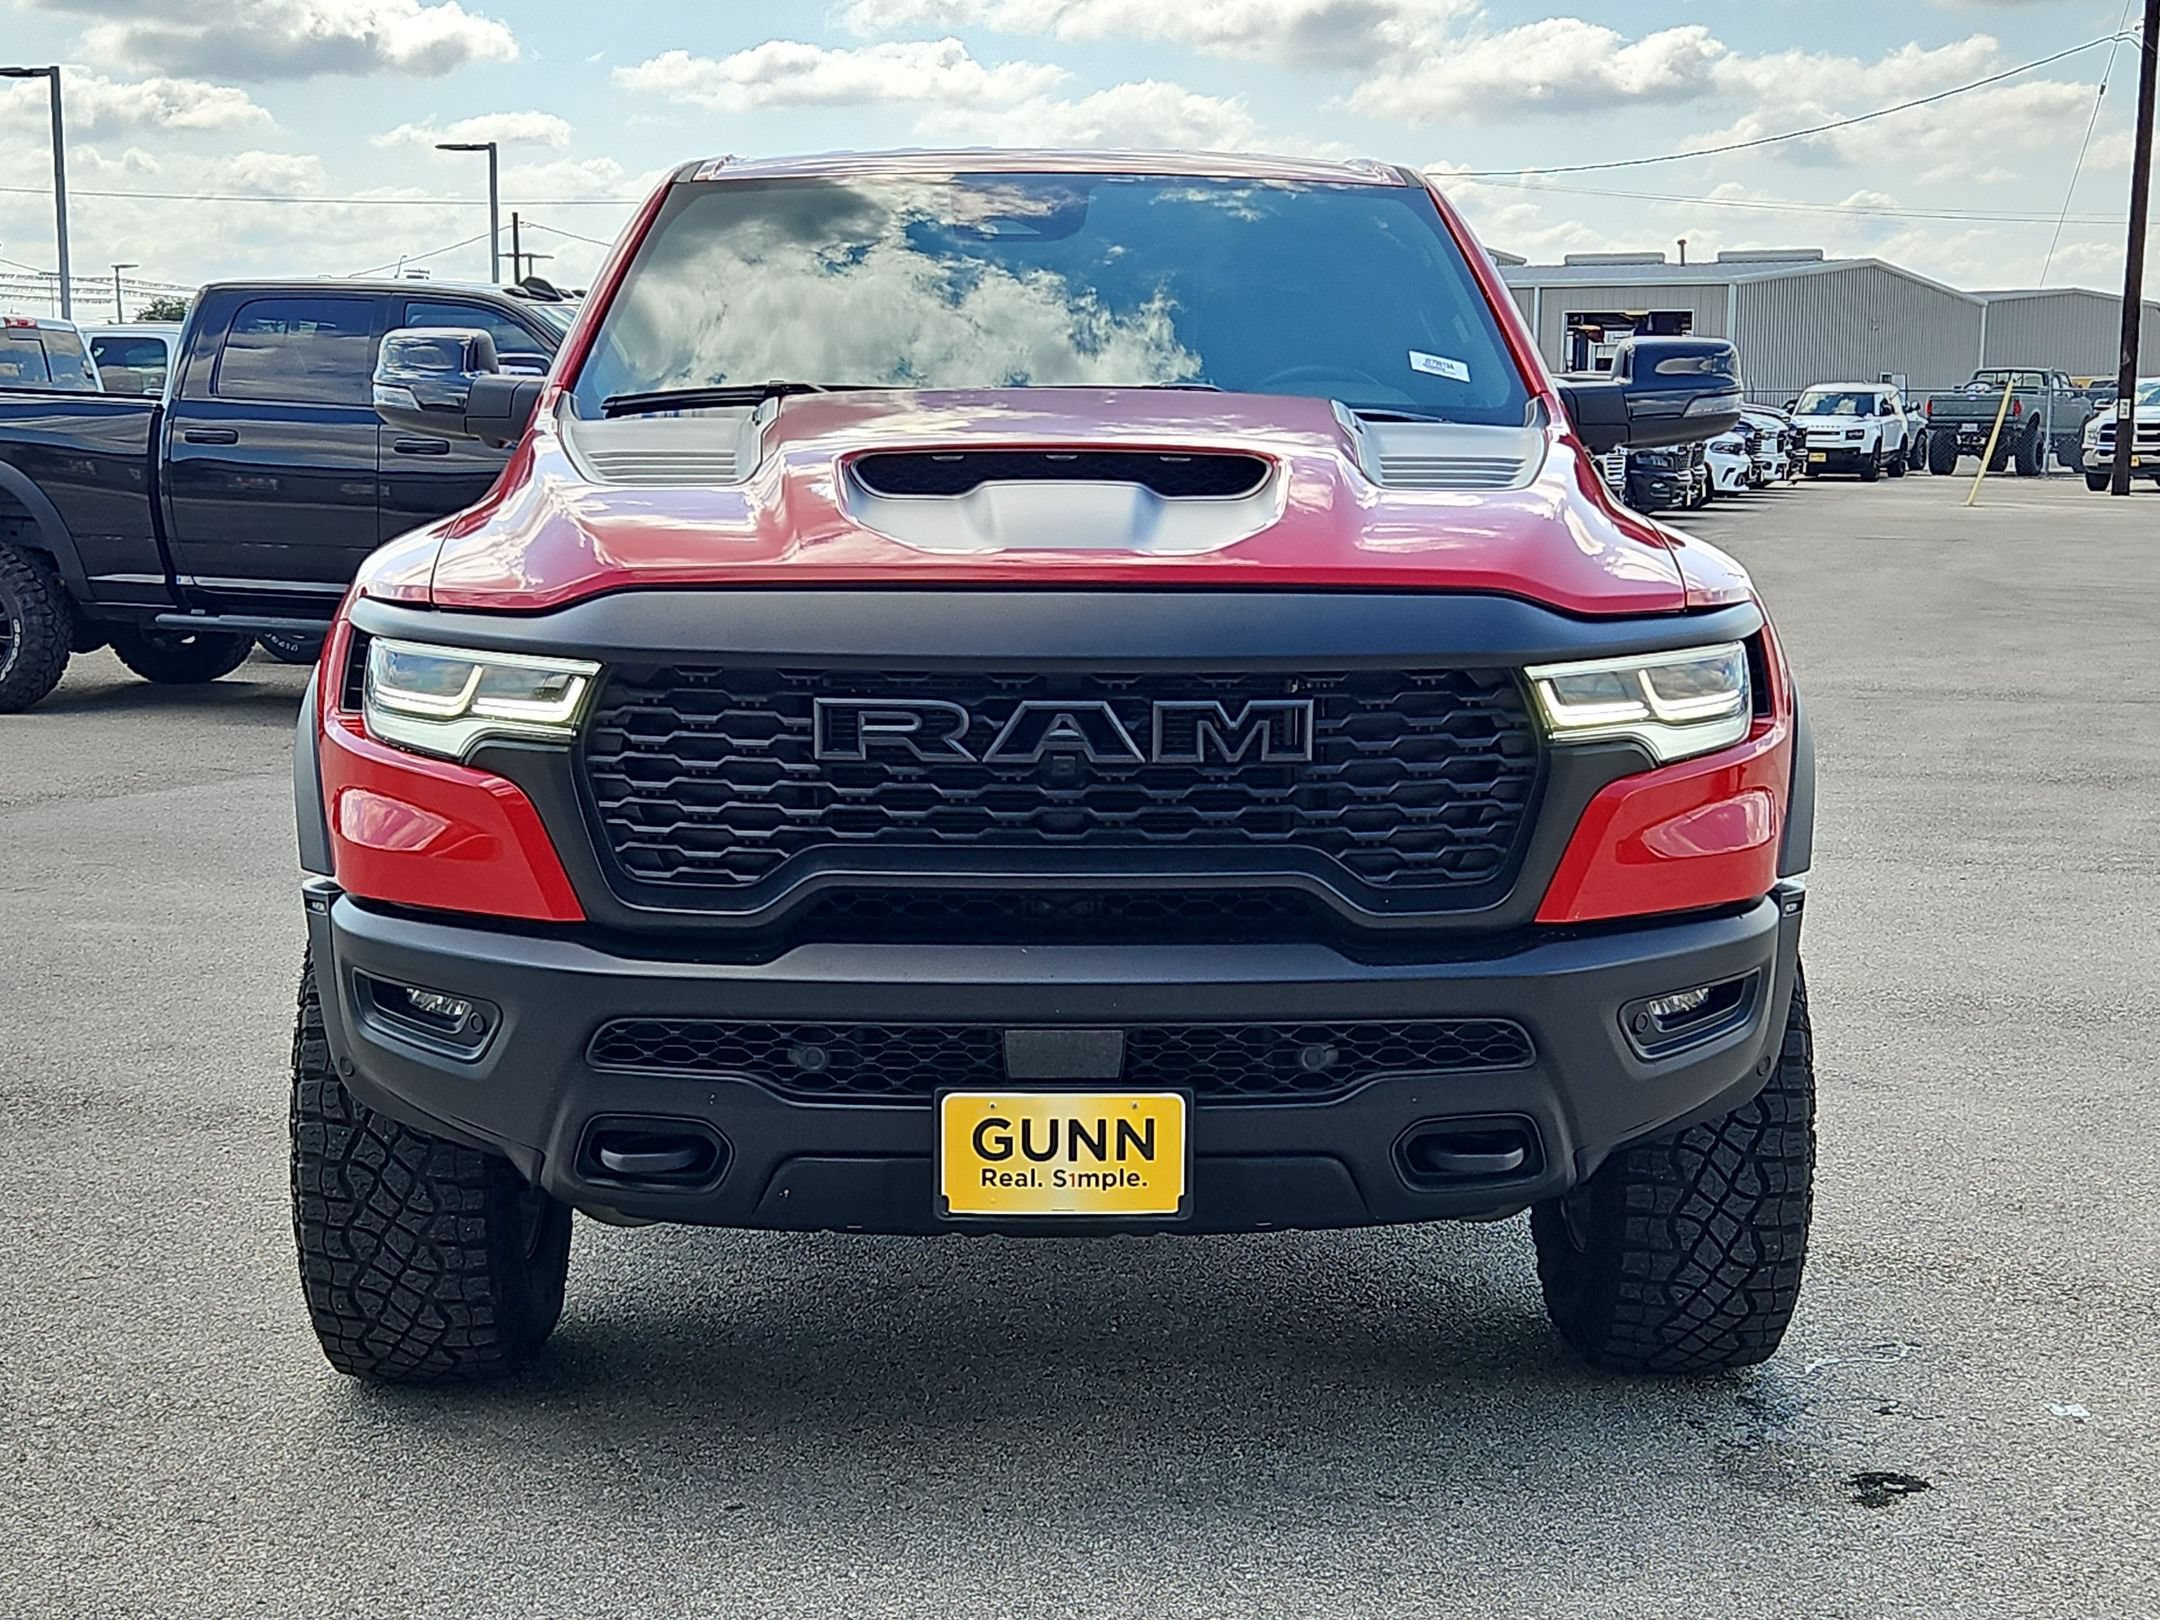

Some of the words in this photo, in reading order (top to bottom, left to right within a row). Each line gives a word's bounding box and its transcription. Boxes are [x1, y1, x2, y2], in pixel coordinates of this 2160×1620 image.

[814, 697, 1314, 763] RAM
[972, 1117, 1155, 1162] GUNN
[981, 1168, 1043, 1187] Real.
